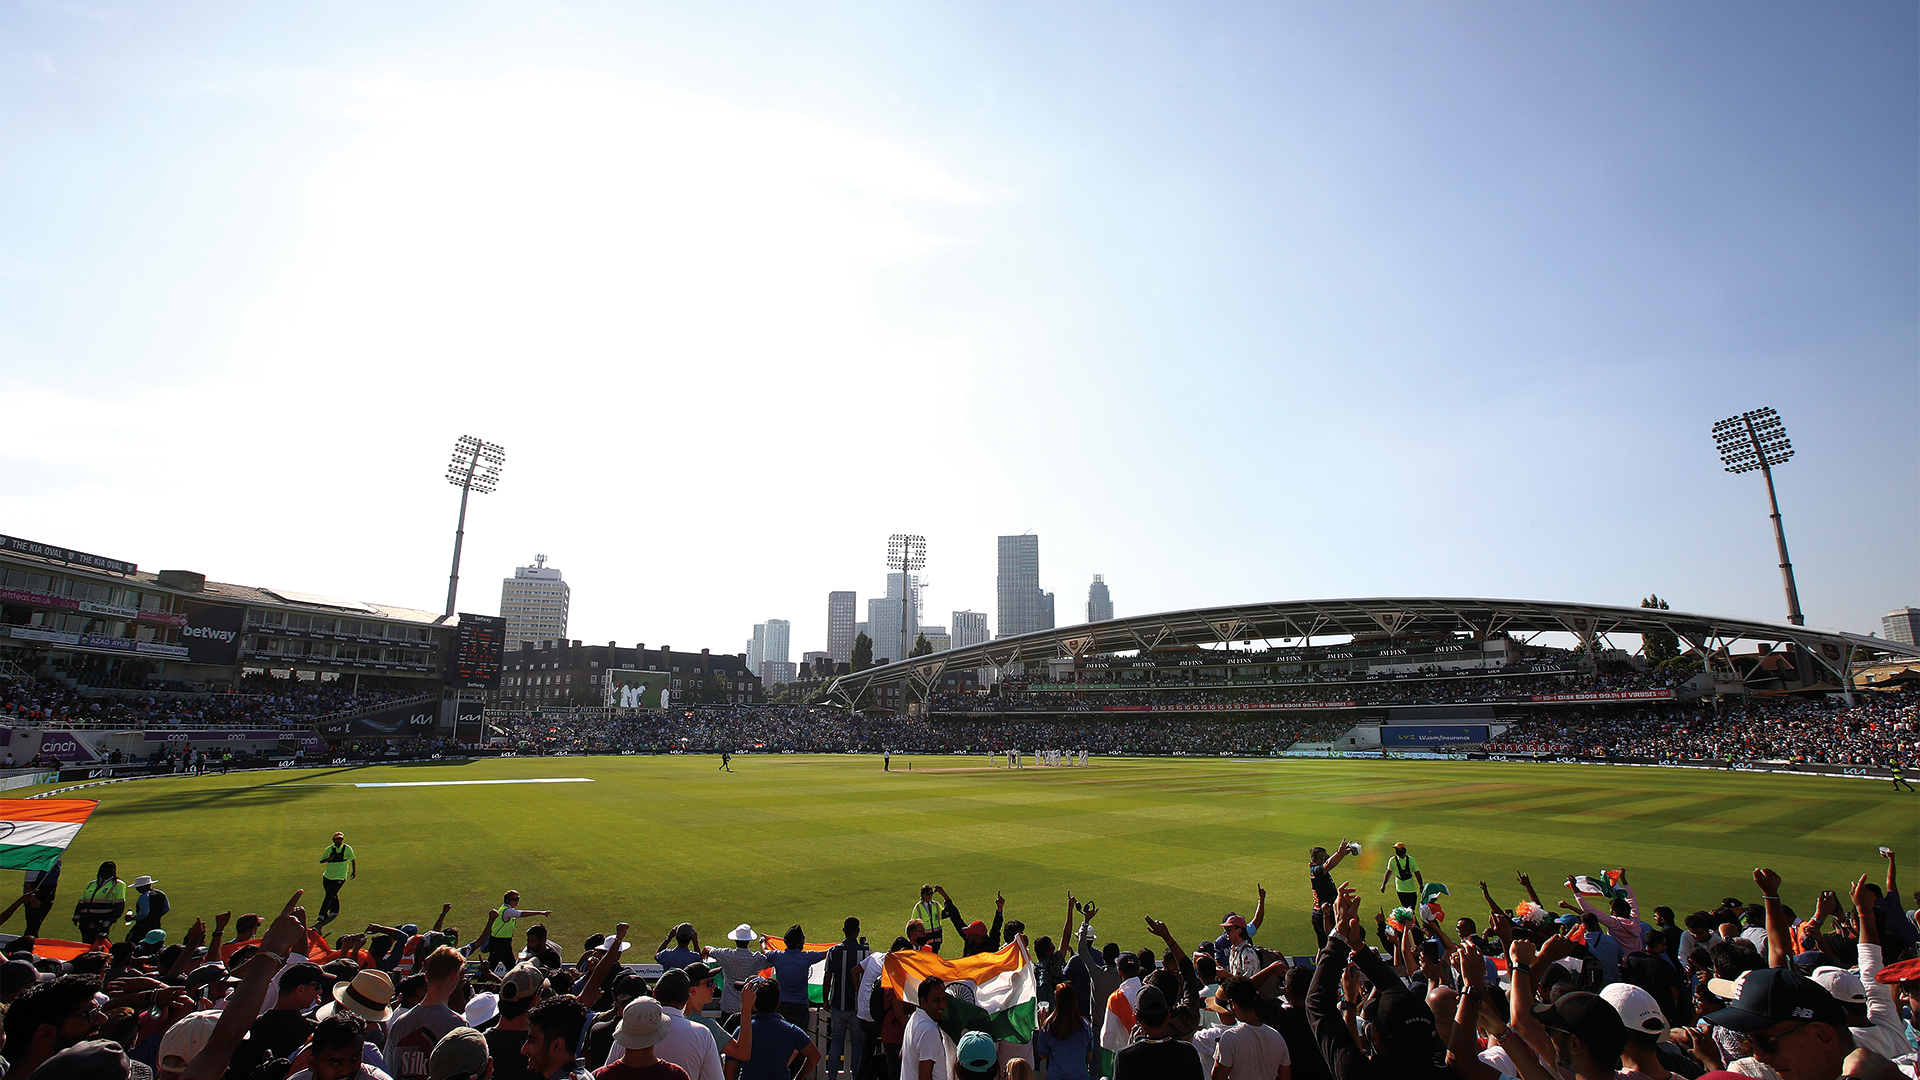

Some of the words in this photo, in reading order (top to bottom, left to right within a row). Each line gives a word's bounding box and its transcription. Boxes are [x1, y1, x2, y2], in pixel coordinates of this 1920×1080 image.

[12, 539, 27, 551] THE
[29, 543, 42, 554] KIA
[44, 546, 63, 559] OVAL
[79, 554, 92, 564] THE
[94, 558, 106, 567] KIA
[106, 561, 123, 571] OVAL
[183, 624, 237, 643] betway
[90, 638, 111, 646] AZAD
[111, 640, 130, 648] AYUB
[410, 713, 434, 725] KIA
[227, 733, 246, 741] cinch
[42, 738, 77, 752] cinch
[401, 1060, 429, 1076] Silk
